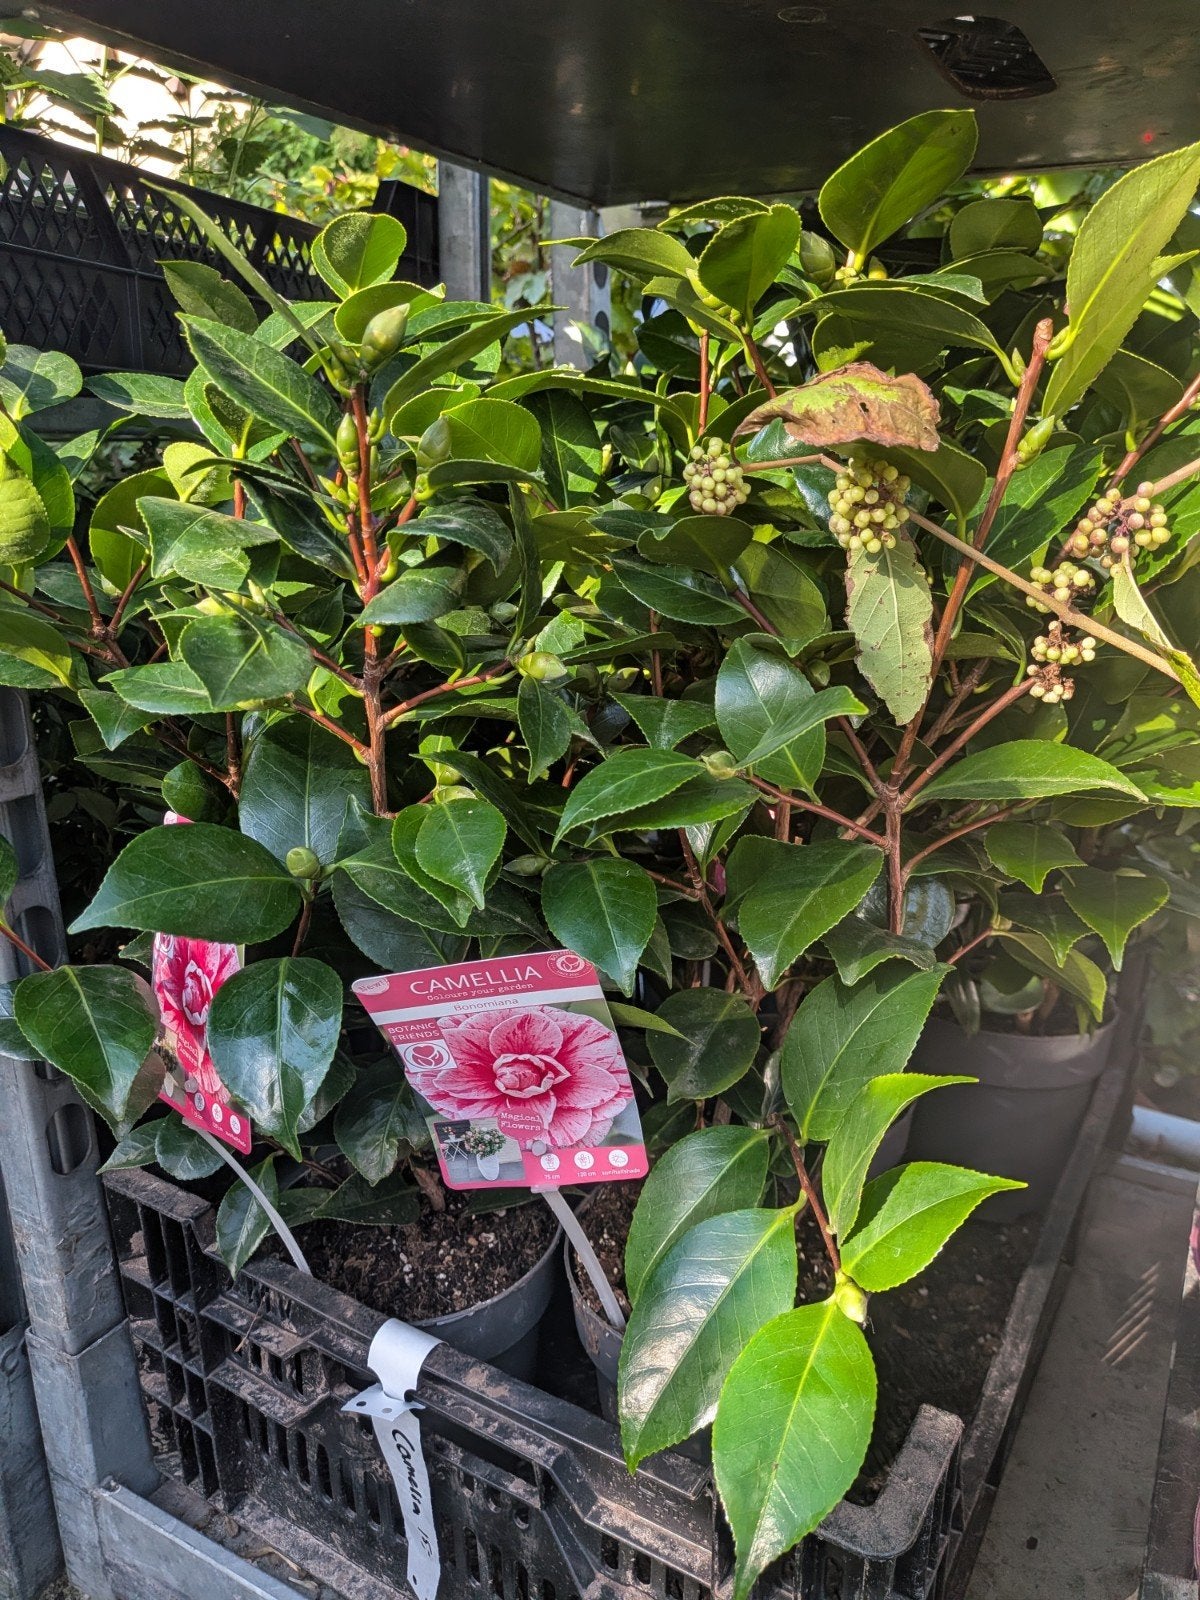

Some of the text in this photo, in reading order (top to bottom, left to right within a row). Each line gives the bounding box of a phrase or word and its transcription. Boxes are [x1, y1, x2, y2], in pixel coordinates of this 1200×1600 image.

[410, 966, 542, 994] CAMELLIA
[427, 983, 534, 1001] Colours your garden
[453, 998, 519, 1011] Bonomiana
[388, 1023, 436, 1034] BOTANIC
[392, 1030, 440, 1041] FRIENDS
[501, 1113, 540, 1121] Magical
[501, 1121, 541, 1131] Flowers
